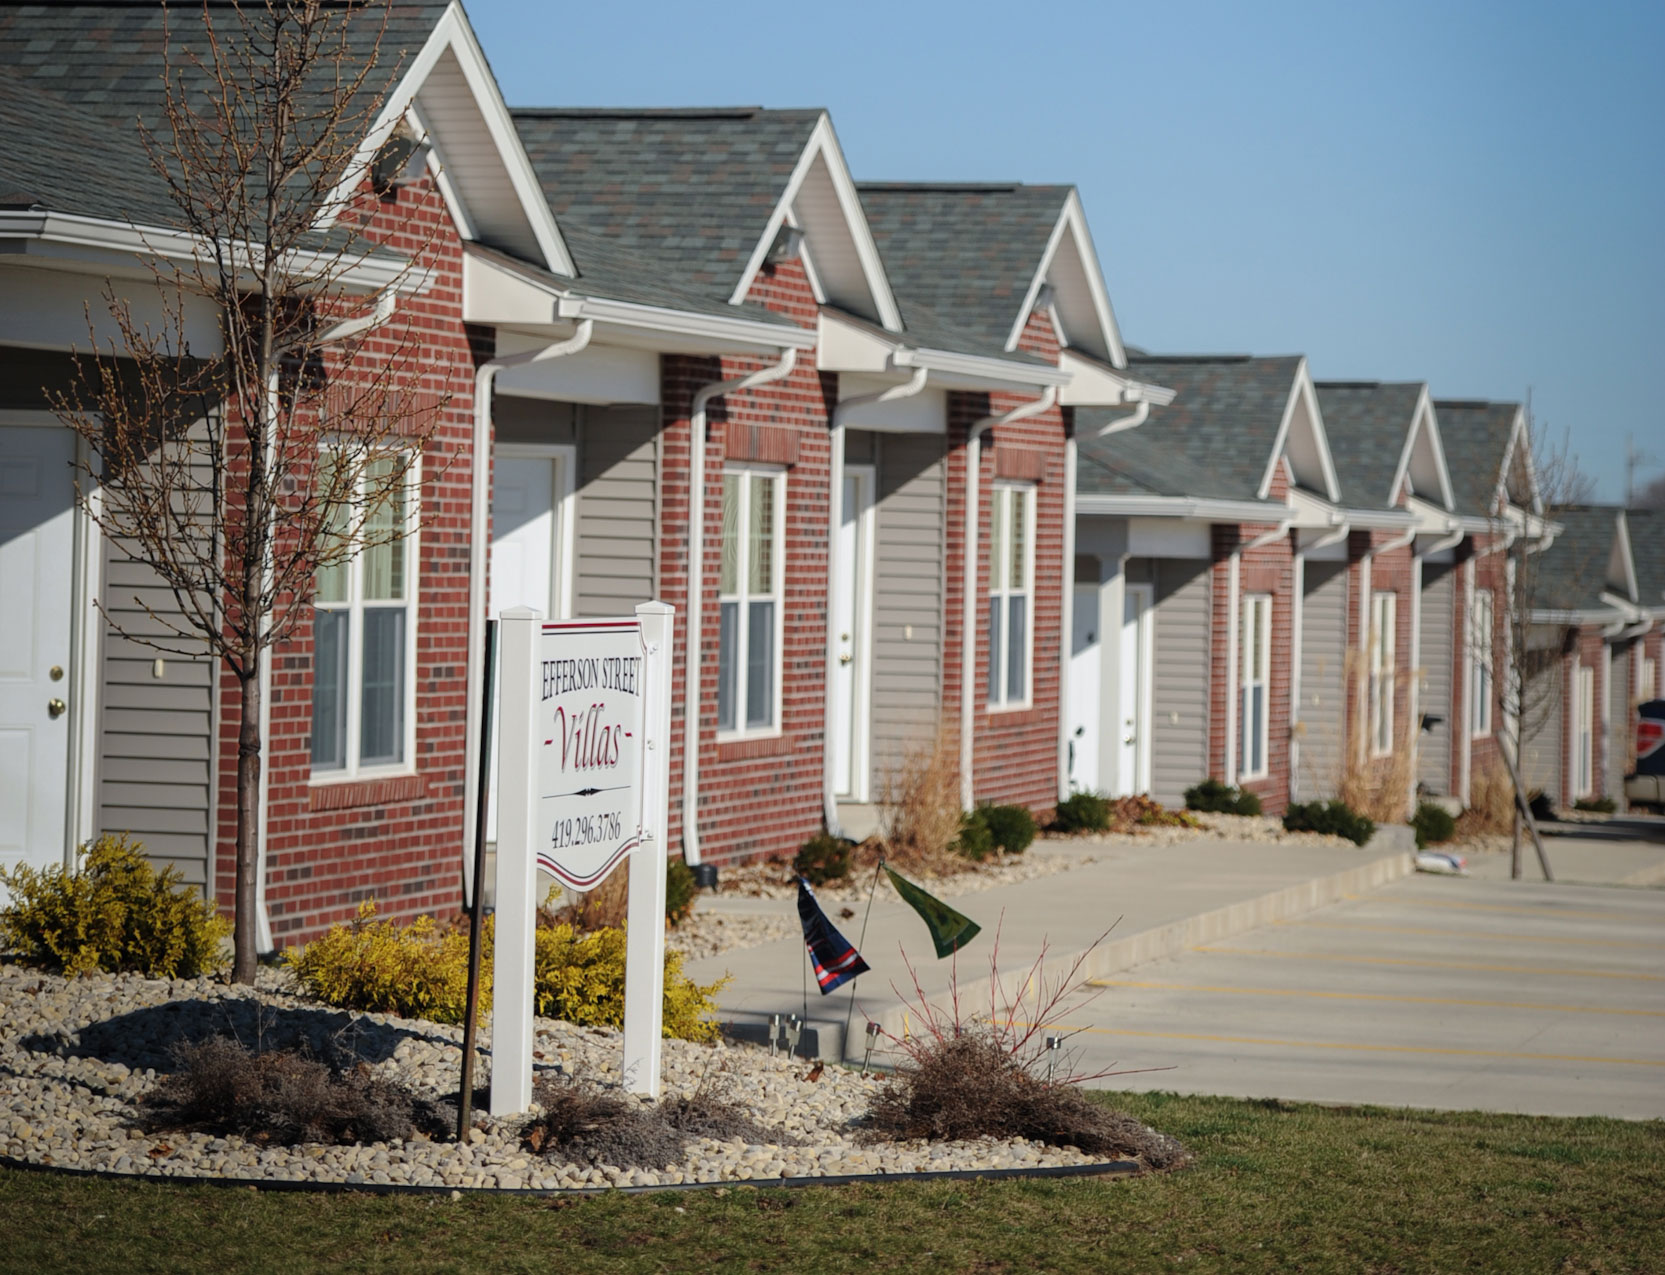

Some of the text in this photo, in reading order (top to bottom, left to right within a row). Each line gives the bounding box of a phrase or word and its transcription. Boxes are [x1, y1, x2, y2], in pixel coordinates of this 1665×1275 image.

[541, 657, 641, 702] EFFERSON STREET
[552, 811, 621, 849] 419.296.3786
